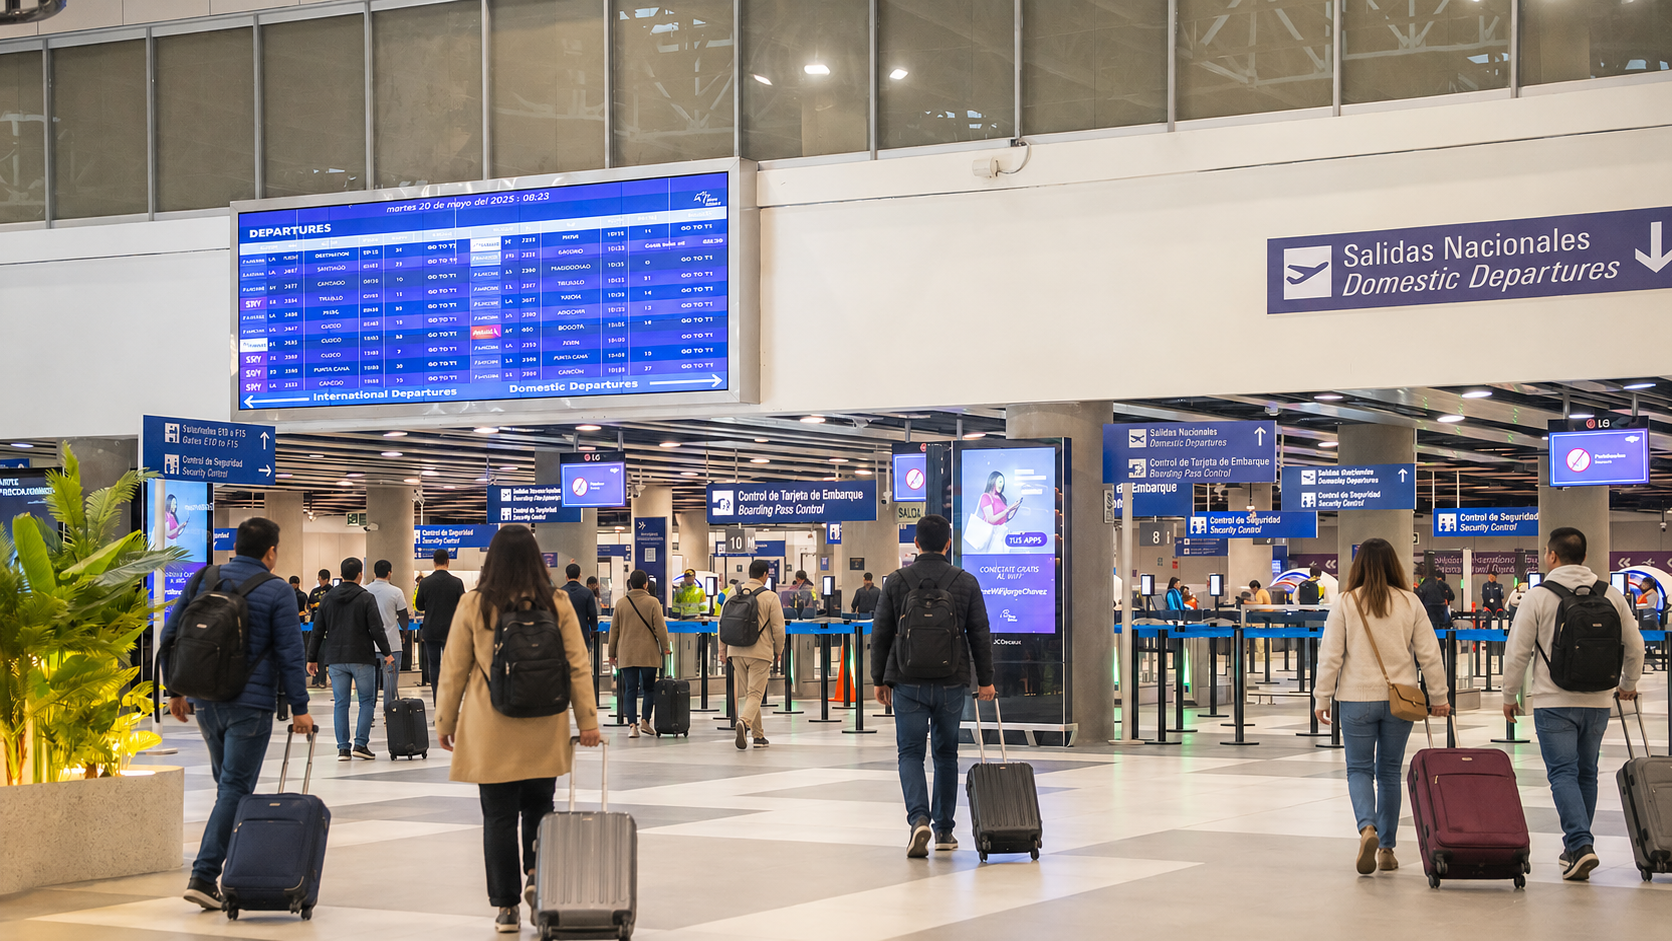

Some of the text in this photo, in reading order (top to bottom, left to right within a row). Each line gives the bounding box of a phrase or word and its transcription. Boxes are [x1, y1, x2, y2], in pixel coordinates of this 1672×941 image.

[387, 204, 416, 213] martes
[419, 202, 430, 210] 20
[447, 200, 472, 210] mayo
[474, 197, 489, 205] del
[491, 195, 514, 204] 2025
[249, 224, 331, 238] DEPARTURES
[1342, 227, 1591, 268] Salidas Nacionales
[1342, 259, 1620, 297] Domestic Departures
[509, 380, 638, 393] Domestic Departures
[313, 388, 457, 401] International Departures
[1150, 458, 1177, 467] Control
[1179, 458, 1189, 467] de
[1231, 457, 1270, 467] Embarque
[1204, 469, 1231, 477] Control
[1132, 483, 1177, 494] Embarque
[738, 488, 863, 503] Control de Tarjeta de Embarque
[738, 504, 825, 518] Boarding Pass Control
[1460, 513, 1487, 522] Control
[1500, 512, 1539, 523] Seguridad
[1210, 517, 1234, 525] Control
[1491, 523, 1518, 531] Control
[730, 537, 742, 549] 10
[1153, 531, 1160, 544] 8
